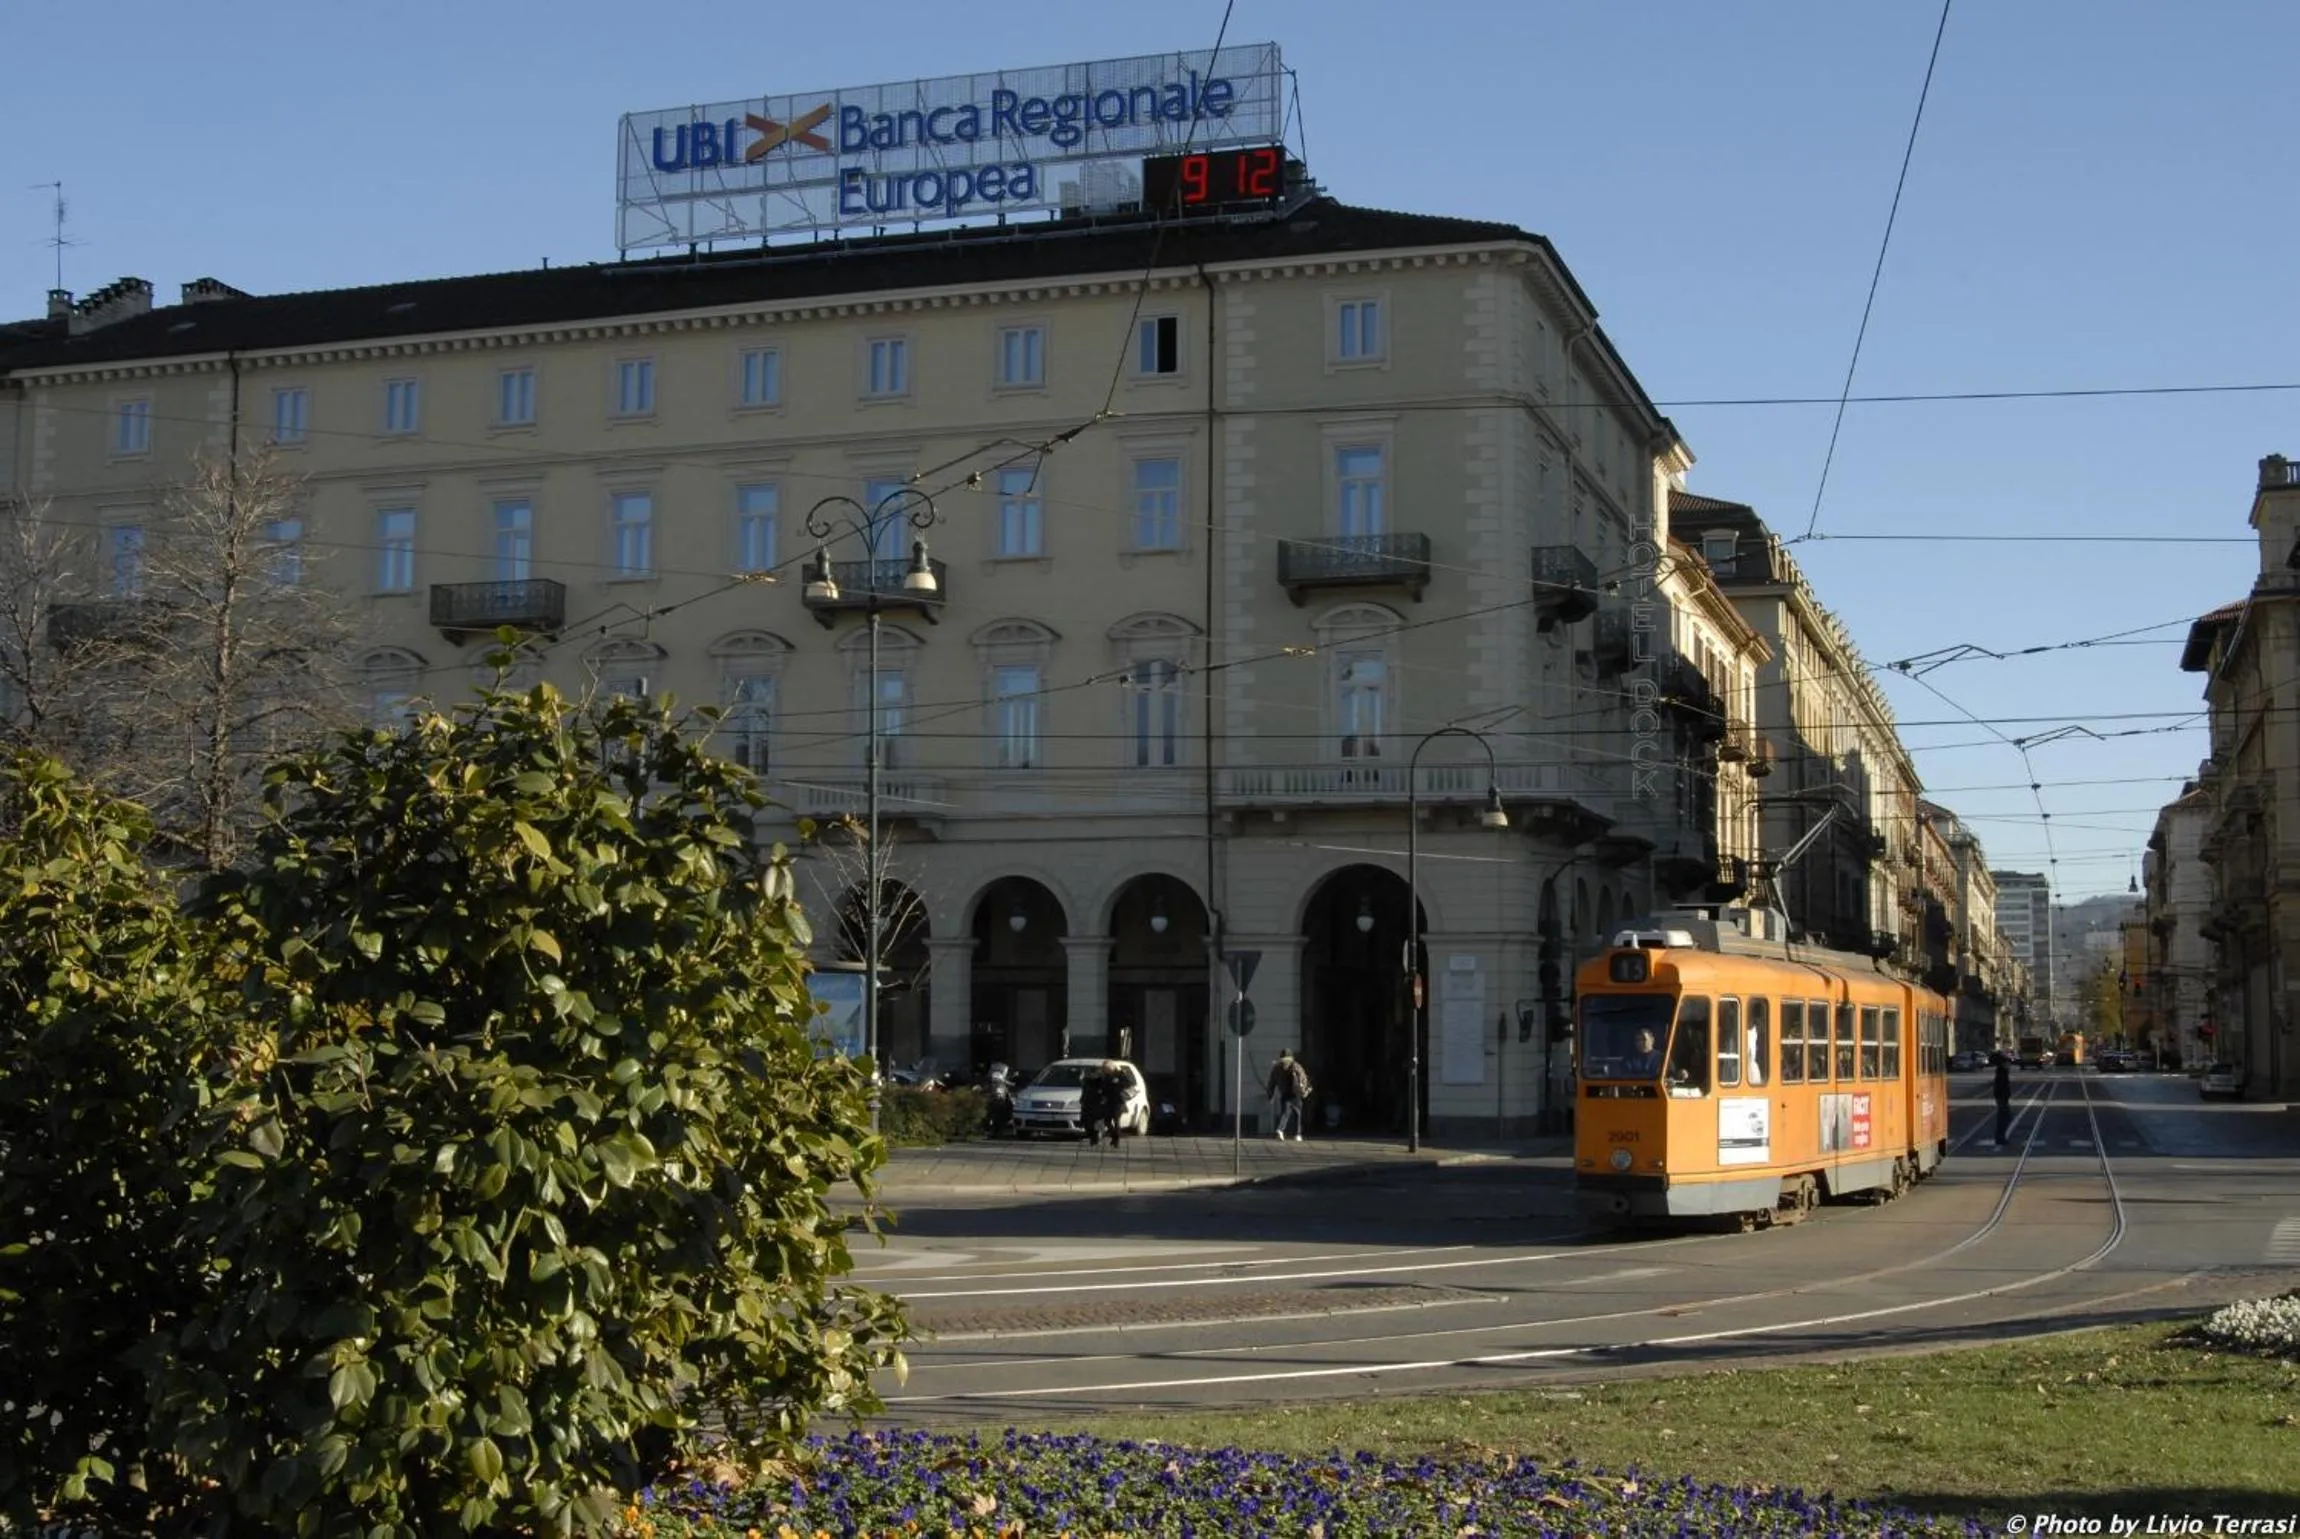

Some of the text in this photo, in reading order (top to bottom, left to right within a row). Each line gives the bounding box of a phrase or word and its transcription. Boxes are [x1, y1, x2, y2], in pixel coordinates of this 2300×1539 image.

[652, 69, 1235, 173] UBI Banca Regionale
[839, 161, 1040, 217] Europea
[1180, 148, 1277, 202] 9 12
[1628, 513, 1658, 662] HOTEL
